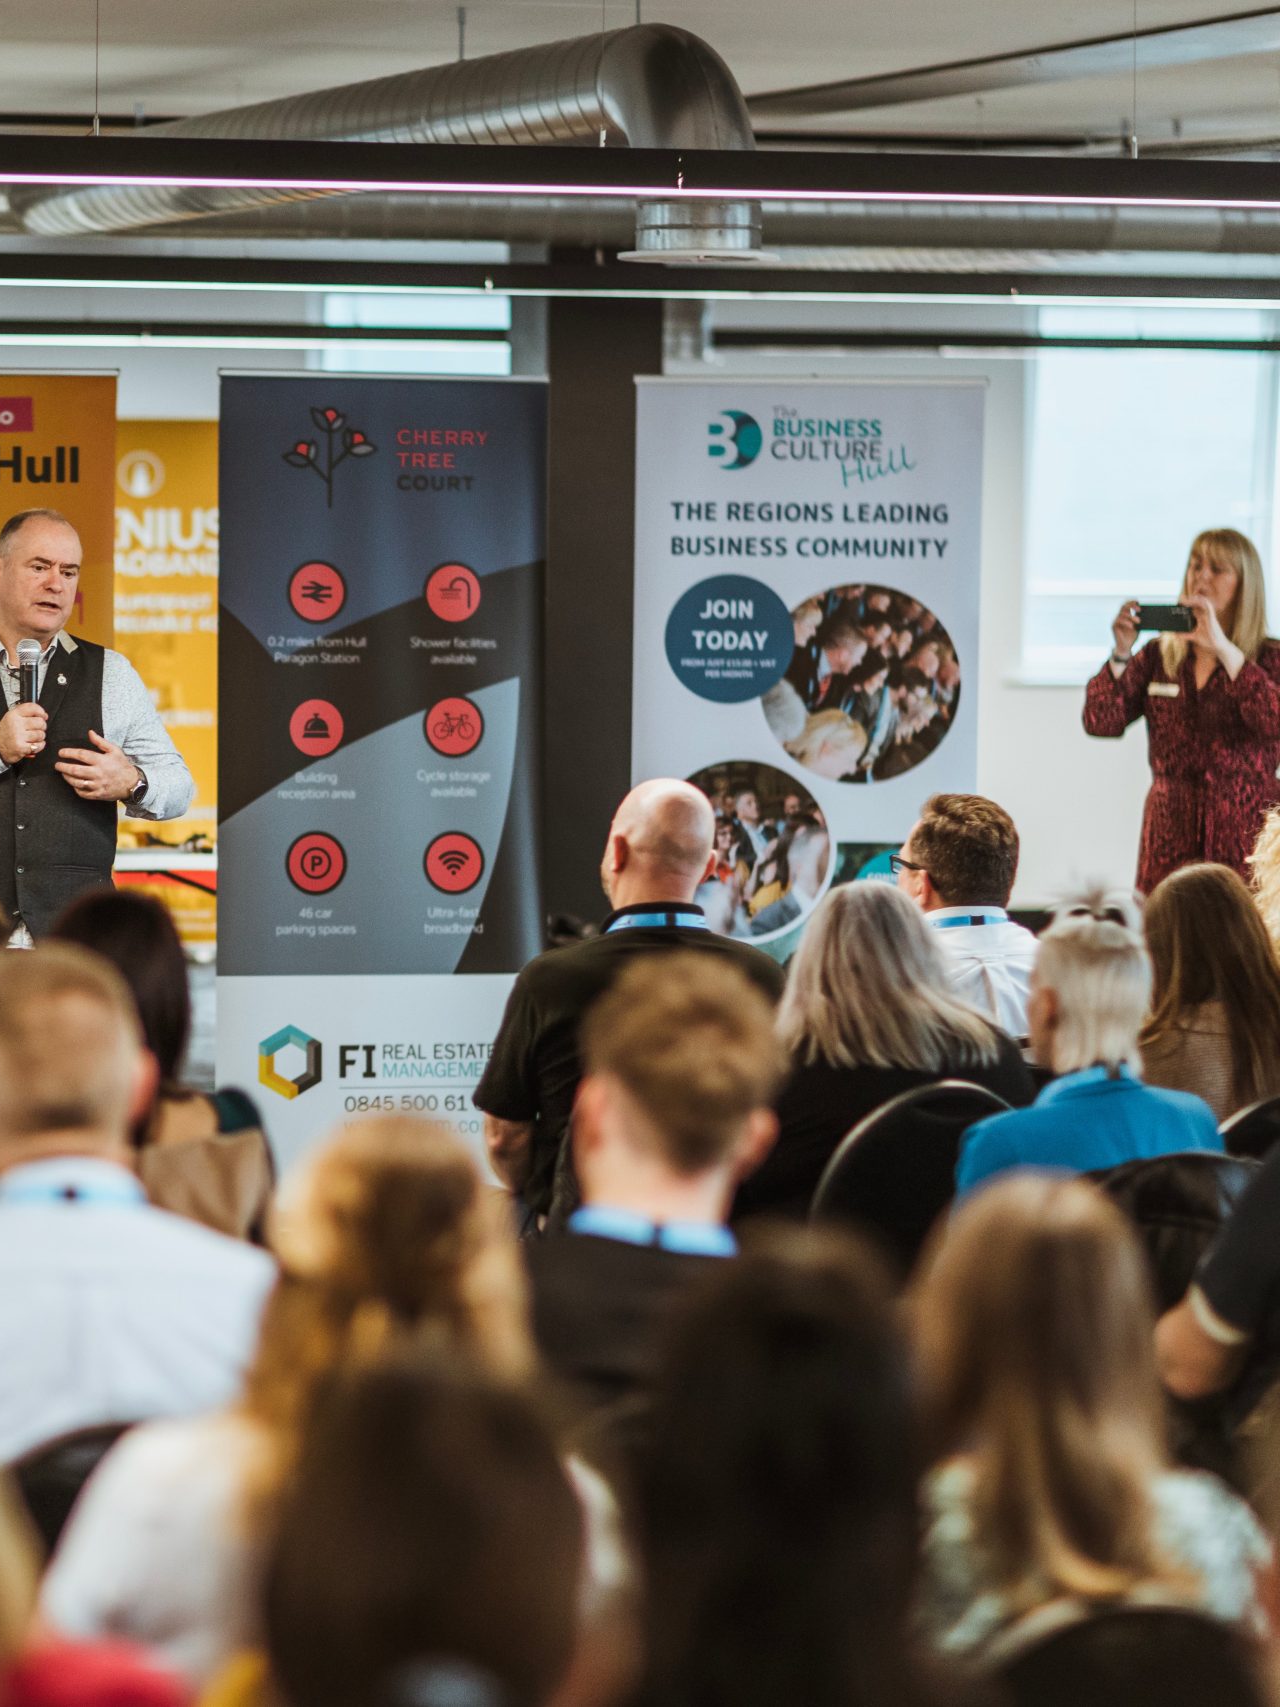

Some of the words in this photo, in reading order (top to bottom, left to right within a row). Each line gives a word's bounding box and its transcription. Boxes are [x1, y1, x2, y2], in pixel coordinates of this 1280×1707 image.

[773, 419, 882, 438] BUSINESS
[396, 429, 489, 446] CHERRY
[771, 440, 882, 461] CULTURE
[396, 453, 456, 469] TREE
[841, 443, 919, 488] Hull
[396, 475, 474, 491] COURT
[670, 502, 718, 521] THE
[726, 502, 834, 523] REGIONS
[842, 503, 949, 524] LEADING
[671, 536, 788, 557] BUSINESS
[796, 537, 948, 558] COMMUNITY
[700, 600, 754, 620] JOIN
[267, 637, 285, 648] 0.2
[286, 636, 314, 648] miles
[317, 636, 344, 648] from
[345, 637, 367, 648] Hull
[410, 637, 451, 649] Shower
[453, 637, 497, 649] facilities
[692, 630, 768, 651] TODAY
[274, 652, 319, 666] Paragon
[321, 652, 361, 664] Station
[430, 653, 477, 665] available
[295, 772, 338, 785] Building
[416, 770, 447, 783] Cycle
[449, 771, 492, 784] storage
[277, 788, 330, 801] reception
[331, 790, 355, 800] area
[430, 786, 477, 798] available
[299, 907, 314, 919] 46
[315, 909, 333, 919] car
[427, 907, 480, 919] Ultra-fast
[275, 923, 316, 937] parking
[318, 924, 356, 936] spaces
[424, 923, 483, 935] broadband
[382, 1044, 427, 1060] REAL
[433, 1043, 495, 1060] ESTATE
[339, 1045, 376, 1078] FI
[382, 1061, 485, 1079] MANAGEME
[344, 1096, 394, 1112] 0845
[401, 1095, 439, 1111] 500
[444, 1095, 468, 1111] 61
